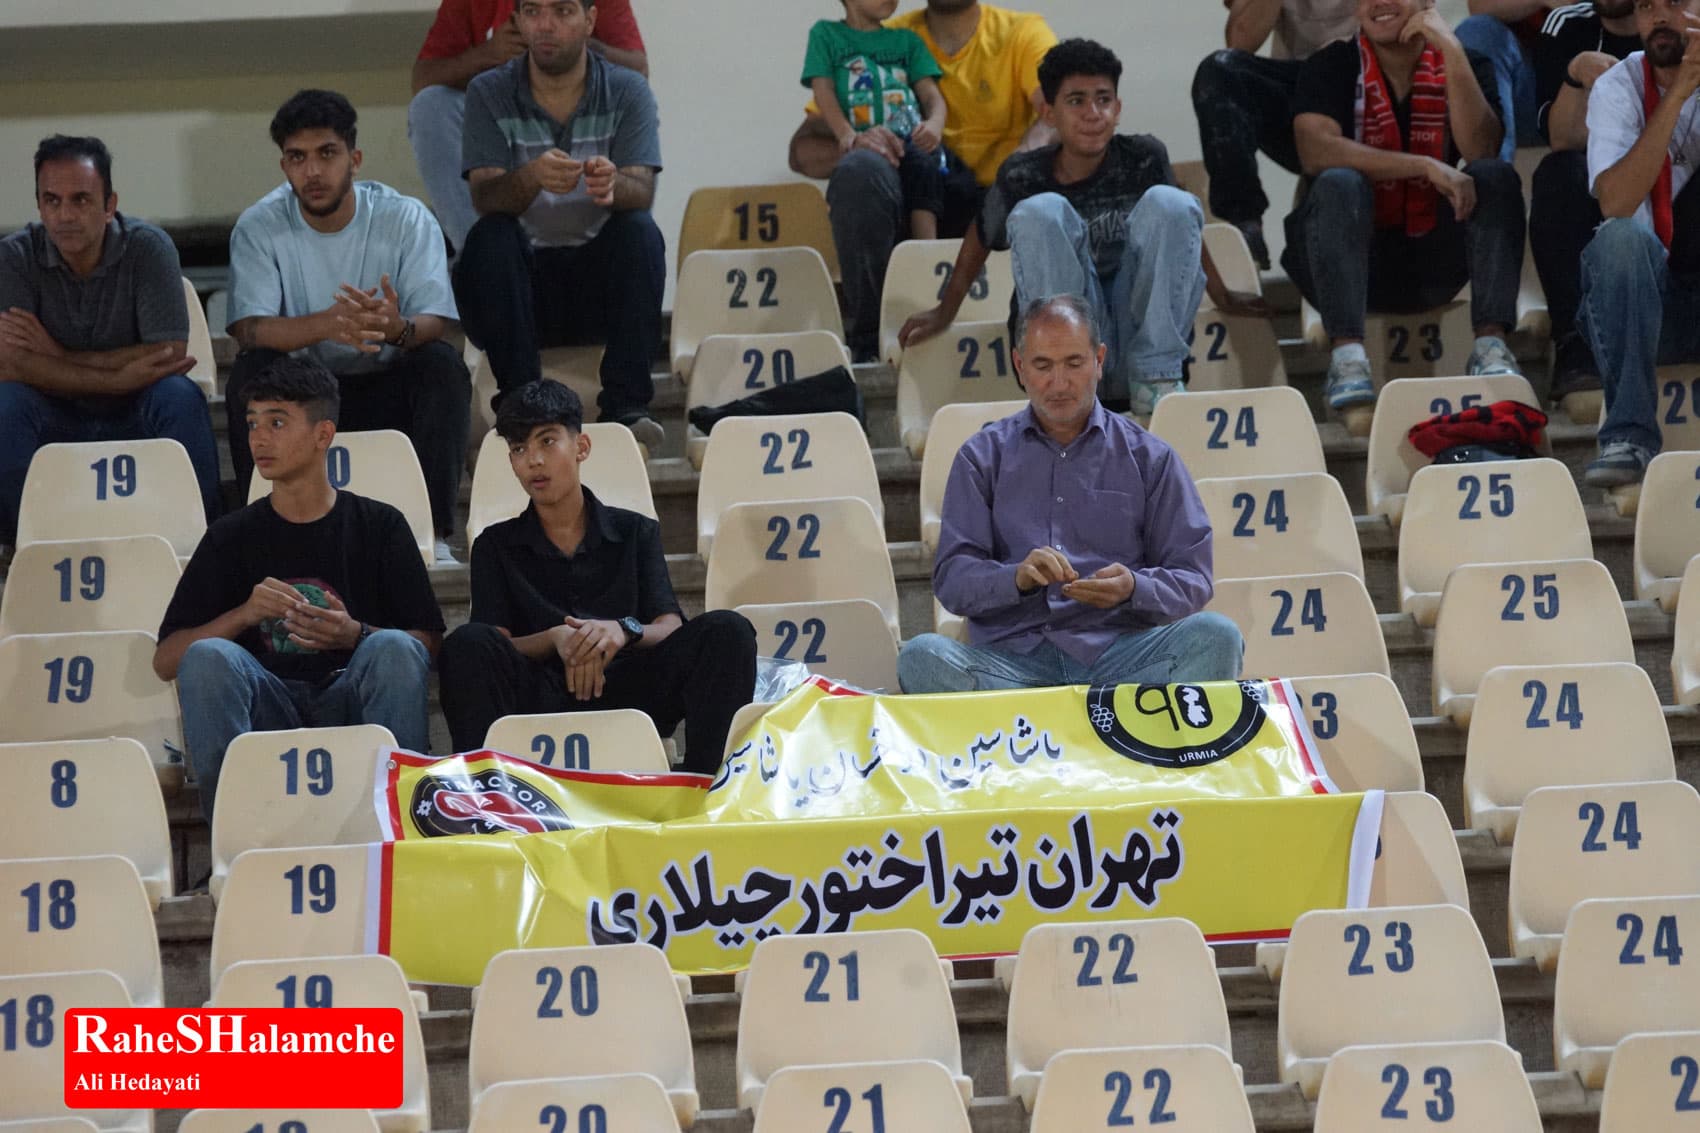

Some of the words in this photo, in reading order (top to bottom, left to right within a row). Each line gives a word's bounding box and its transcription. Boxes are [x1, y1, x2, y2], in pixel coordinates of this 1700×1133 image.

[734, 203, 779, 242] 15
[727, 267, 779, 308] 22
[958, 337, 1007, 378] 21
[1388, 323, 1442, 364] 23
[743, 349, 795, 388] 20
[1207, 406, 1258, 449] 24
[327, 446, 350, 488] 0
[761, 429, 812, 474] 22
[91, 455, 136, 500] 19
[1458, 474, 1514, 519] 25
[1233, 490, 1288, 536] 24
[766, 514, 820, 561] 22
[54, 556, 105, 602] 19
[1501, 574, 1559, 620] 25
[1271, 588, 1327, 636] 24
[773, 618, 826, 665] 22
[45, 656, 93, 703] 19
[1312, 692, 1338, 739] 3
[1523, 680, 1583, 729] 24
[280, 748, 333, 796] 19
[531, 733, 590, 770] 20
[1178, 749, 1219, 763] URMIA
[51, 760, 77, 808] 8
[440, 776, 547, 813] TRACTOR
[1579, 802, 1641, 852] 24
[1028, 811, 1181, 910] تهران
[21, 880, 76, 932] 18
[284, 864, 336, 914] 19
[1074, 934, 1137, 986] 22
[1344, 922, 1414, 976] 23
[1617, 914, 1682, 965] 24
[276, 975, 332, 1007] 19
[536, 965, 598, 1018] 20
[804, 951, 859, 1002] 21
[0, 995, 54, 1051] 18
[1104, 1069, 1176, 1126] 22
[1381, 1064, 1454, 1122] 23
[1671, 1056, 1700, 1111] 2
[540, 1104, 606, 1133] 20
[824, 1084, 884, 1133] 21
